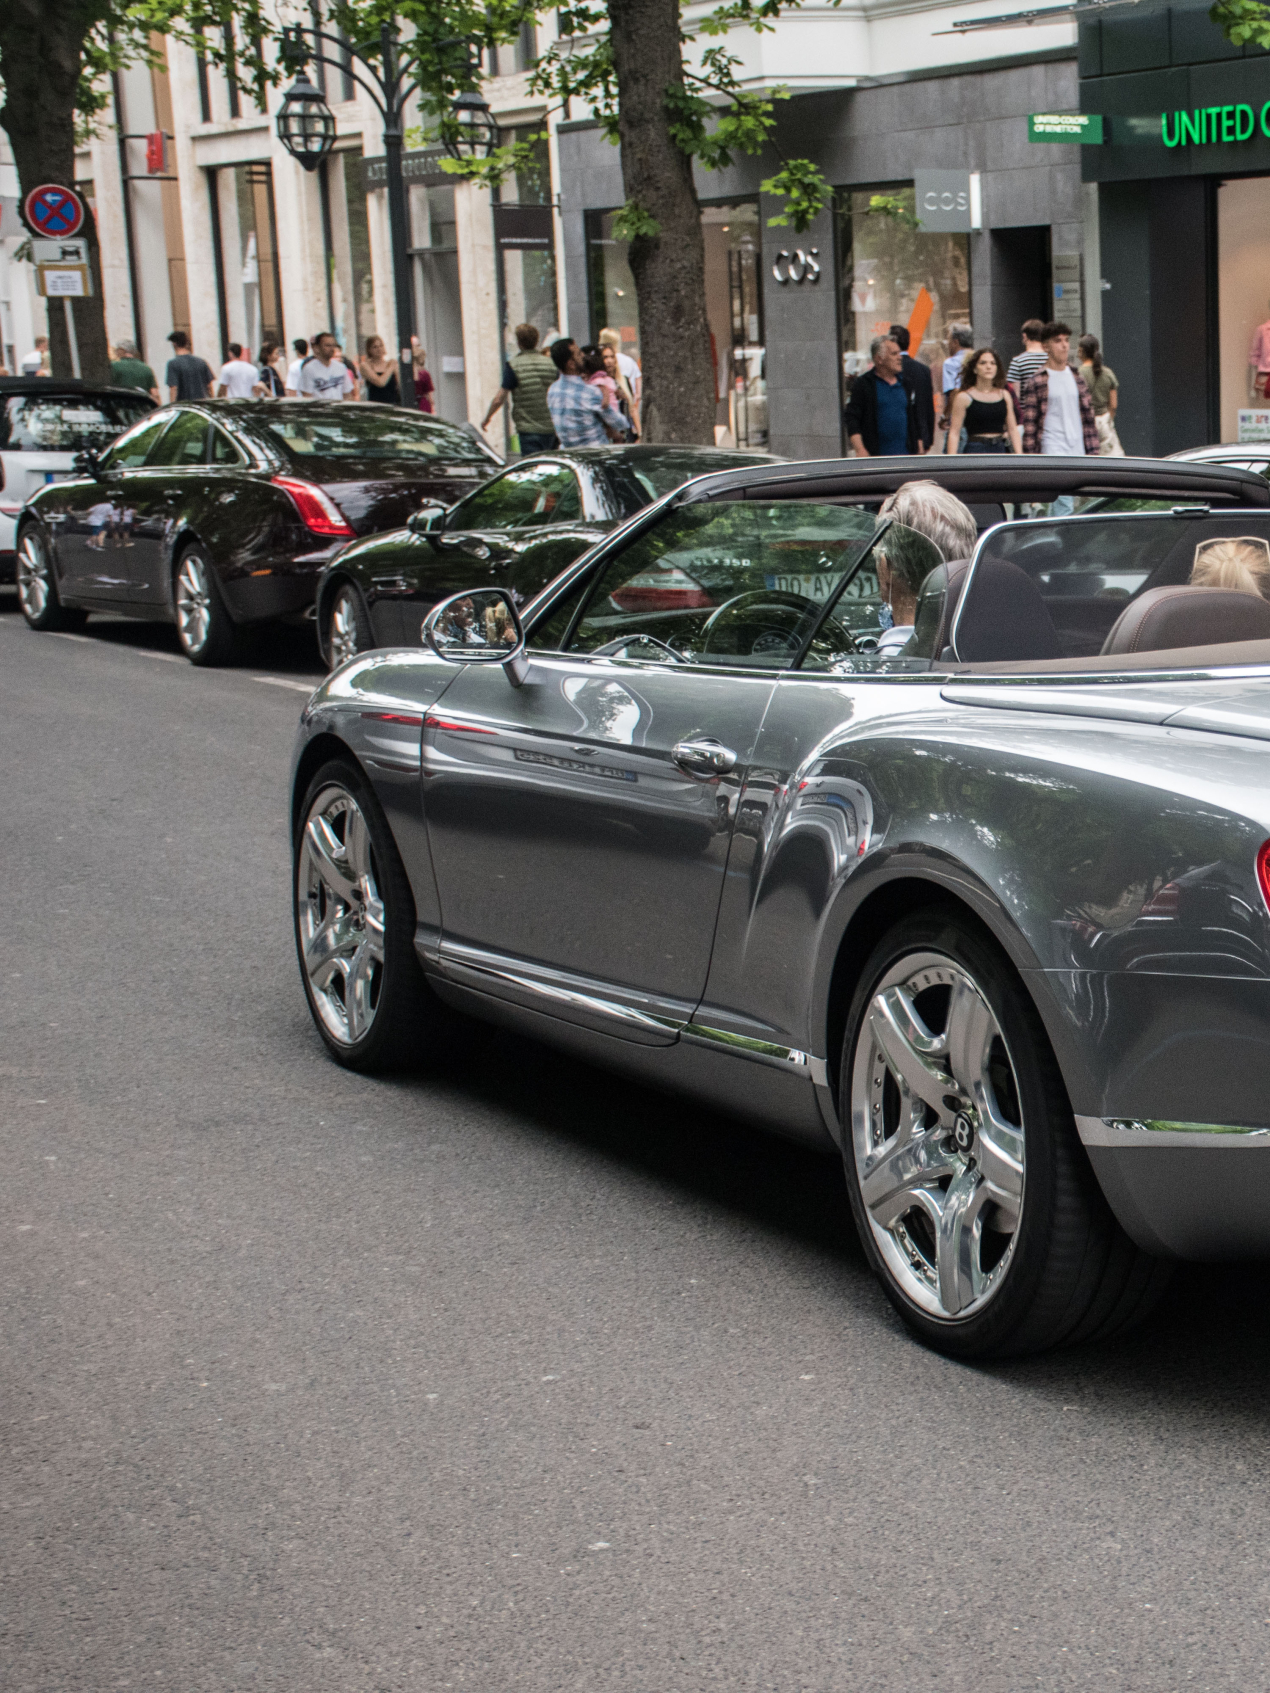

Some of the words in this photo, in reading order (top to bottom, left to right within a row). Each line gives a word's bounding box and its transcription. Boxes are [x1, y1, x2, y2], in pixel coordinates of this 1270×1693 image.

[1162, 104, 1255, 147] UNITED
[924, 191, 967, 211] COS
[772, 247, 820, 286] COS
[1255, 415, 1270, 424] are
[955, 1117, 970, 1147] B
